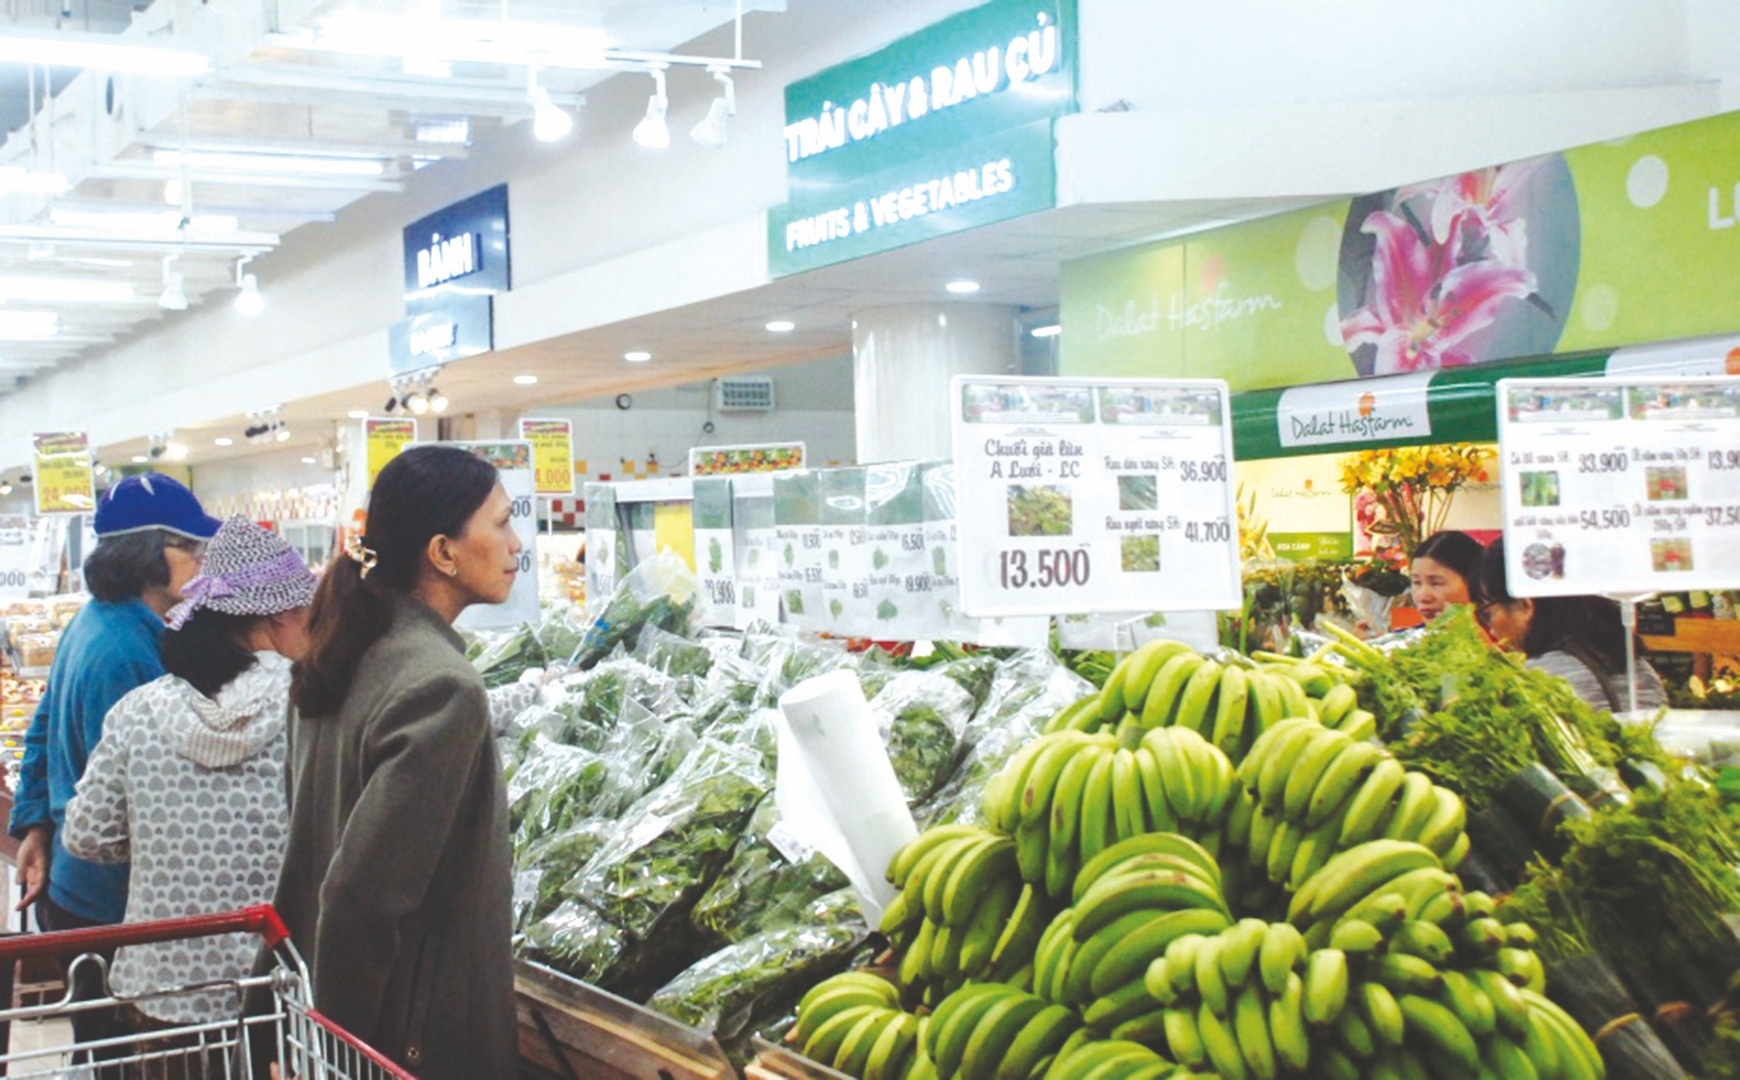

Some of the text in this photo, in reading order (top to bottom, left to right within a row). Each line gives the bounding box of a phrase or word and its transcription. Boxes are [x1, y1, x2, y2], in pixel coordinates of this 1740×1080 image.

[783, 12, 1055, 162] TRÁI CÂY & RAU CỦ
[786, 158, 1013, 251] FRUITS & VEGETABLES
[1709, 181, 1740, 229] L
[1291, 409, 1413, 439] Dalat Hasfarm
[990, 460, 1003, 478] A
[1180, 460, 1227, 481] 36.900
[1185, 520, 1231, 542] 41.700
[1000, 548, 1090, 590] 13.500
